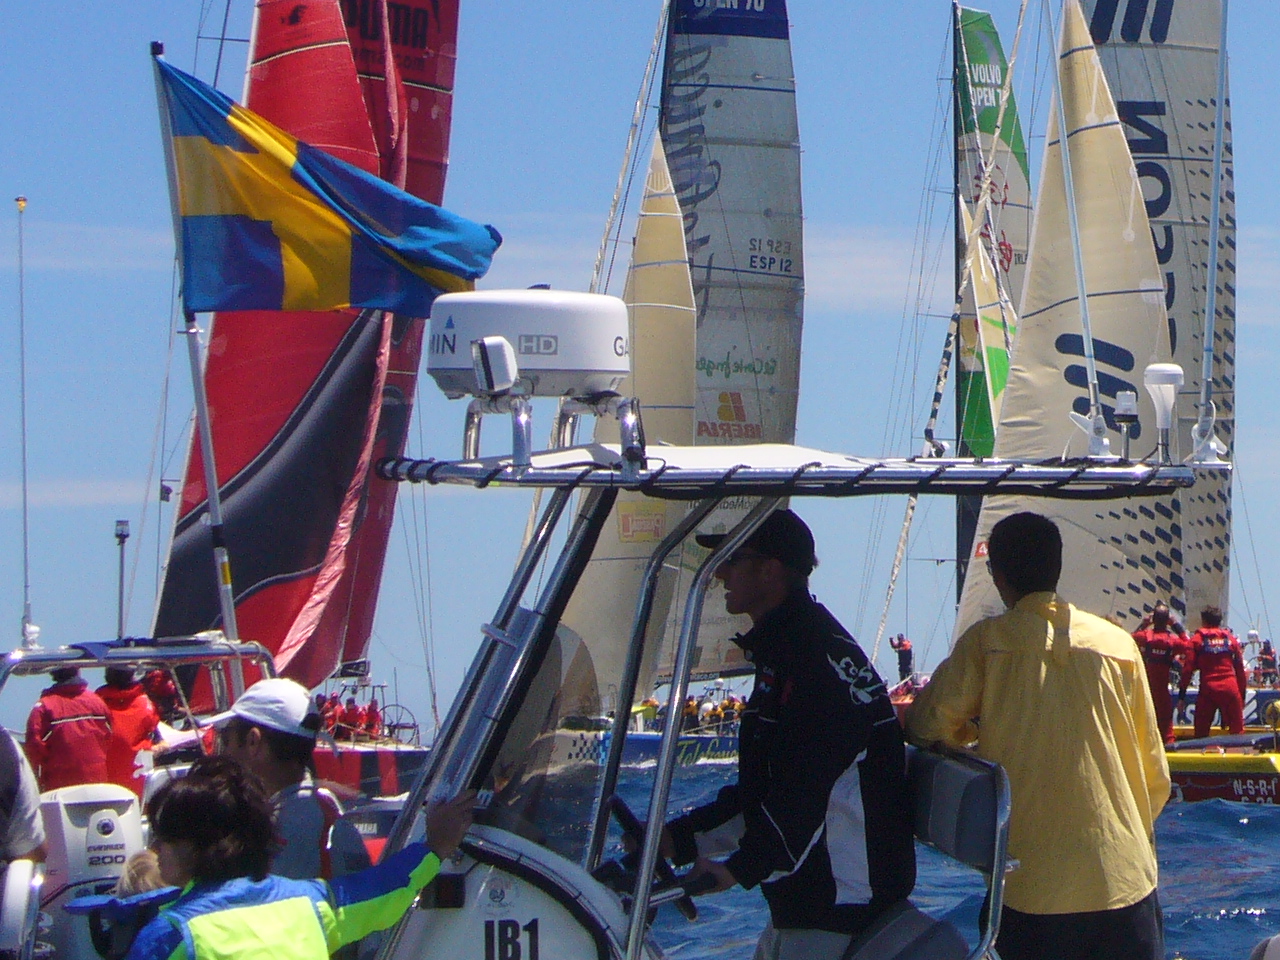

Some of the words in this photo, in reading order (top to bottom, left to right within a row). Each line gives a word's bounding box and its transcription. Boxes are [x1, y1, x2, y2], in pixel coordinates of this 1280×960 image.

[971, 63, 1002, 85] VOLVO
[971, 87, 996, 108] OPEN
[750, 254, 776, 271] ESP
[780, 257, 793, 273] 12
[520, 336, 558, 354] HD
[88, 855, 126, 866] 200
